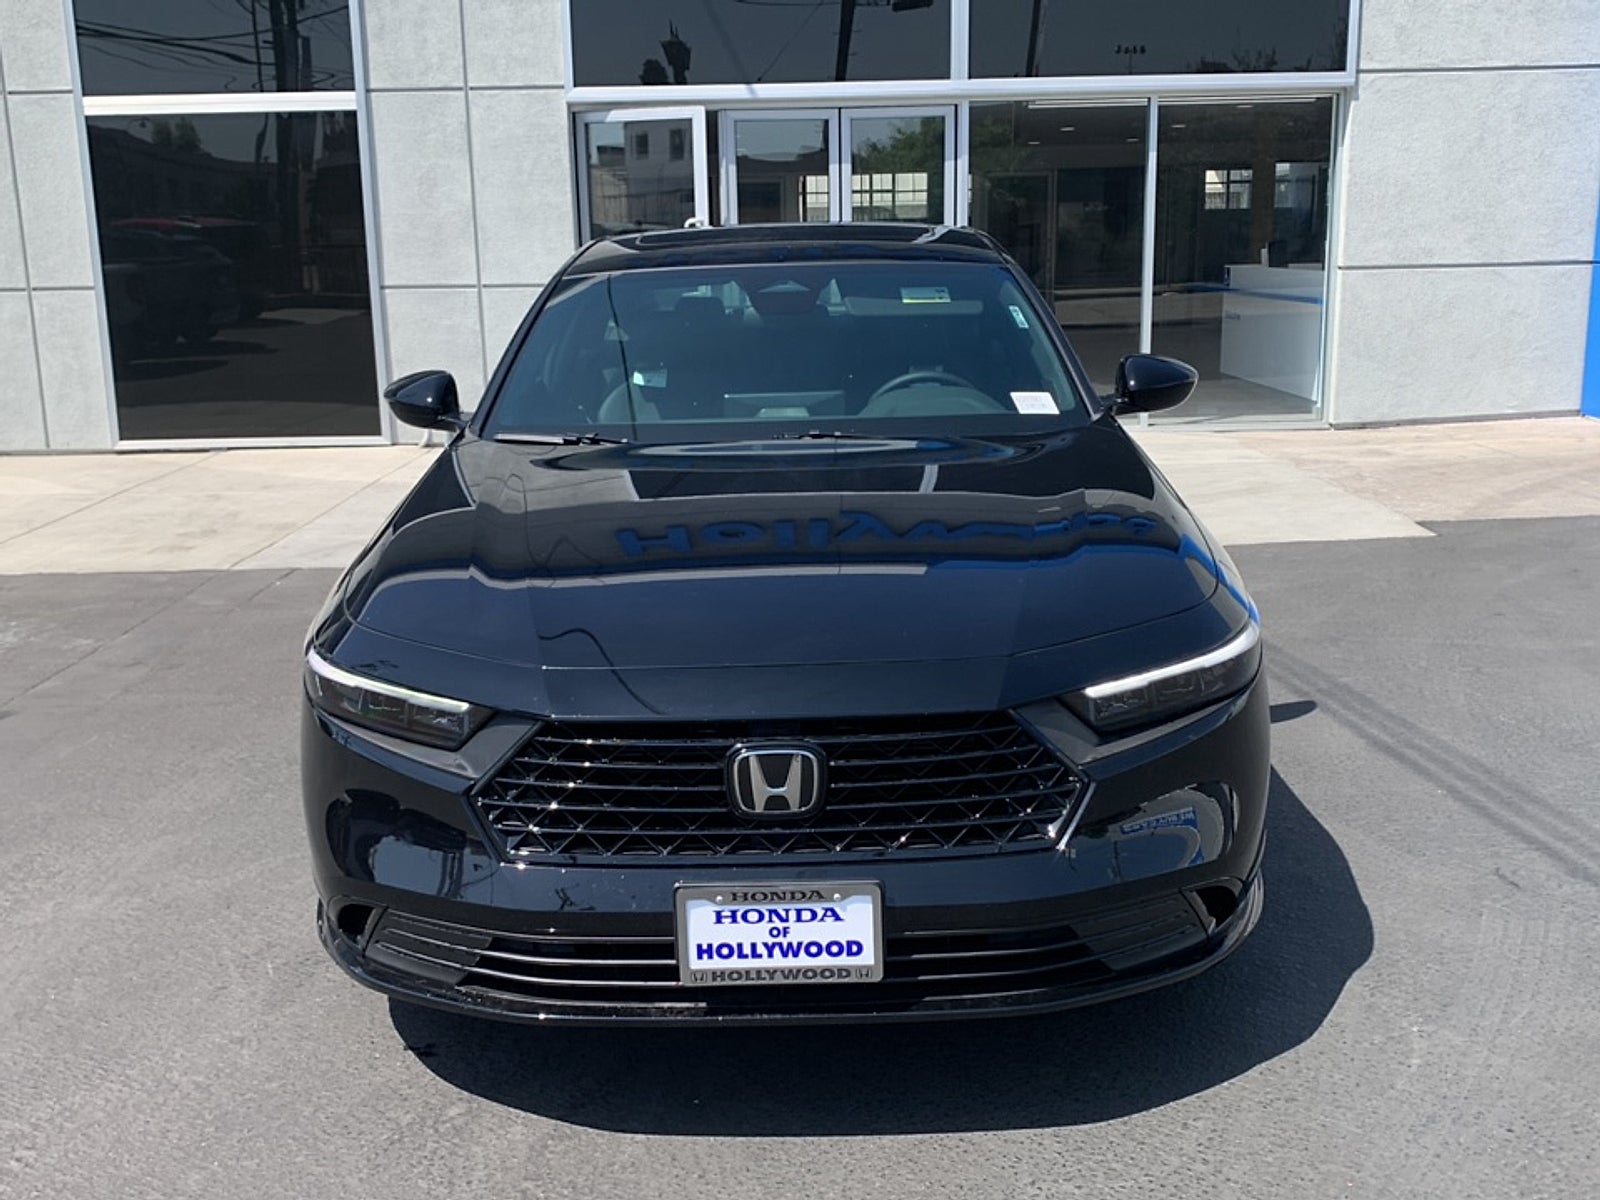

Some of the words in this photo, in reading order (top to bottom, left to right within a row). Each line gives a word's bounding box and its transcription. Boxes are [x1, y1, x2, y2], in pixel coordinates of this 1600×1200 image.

[730, 890, 826, 902] HONDA
[713, 907, 844, 924] HONDA
[768, 926, 791, 938] OF
[696, 940, 864, 960] HOLLYWOOD
[711, 968, 851, 982] HOLLYWOOD
